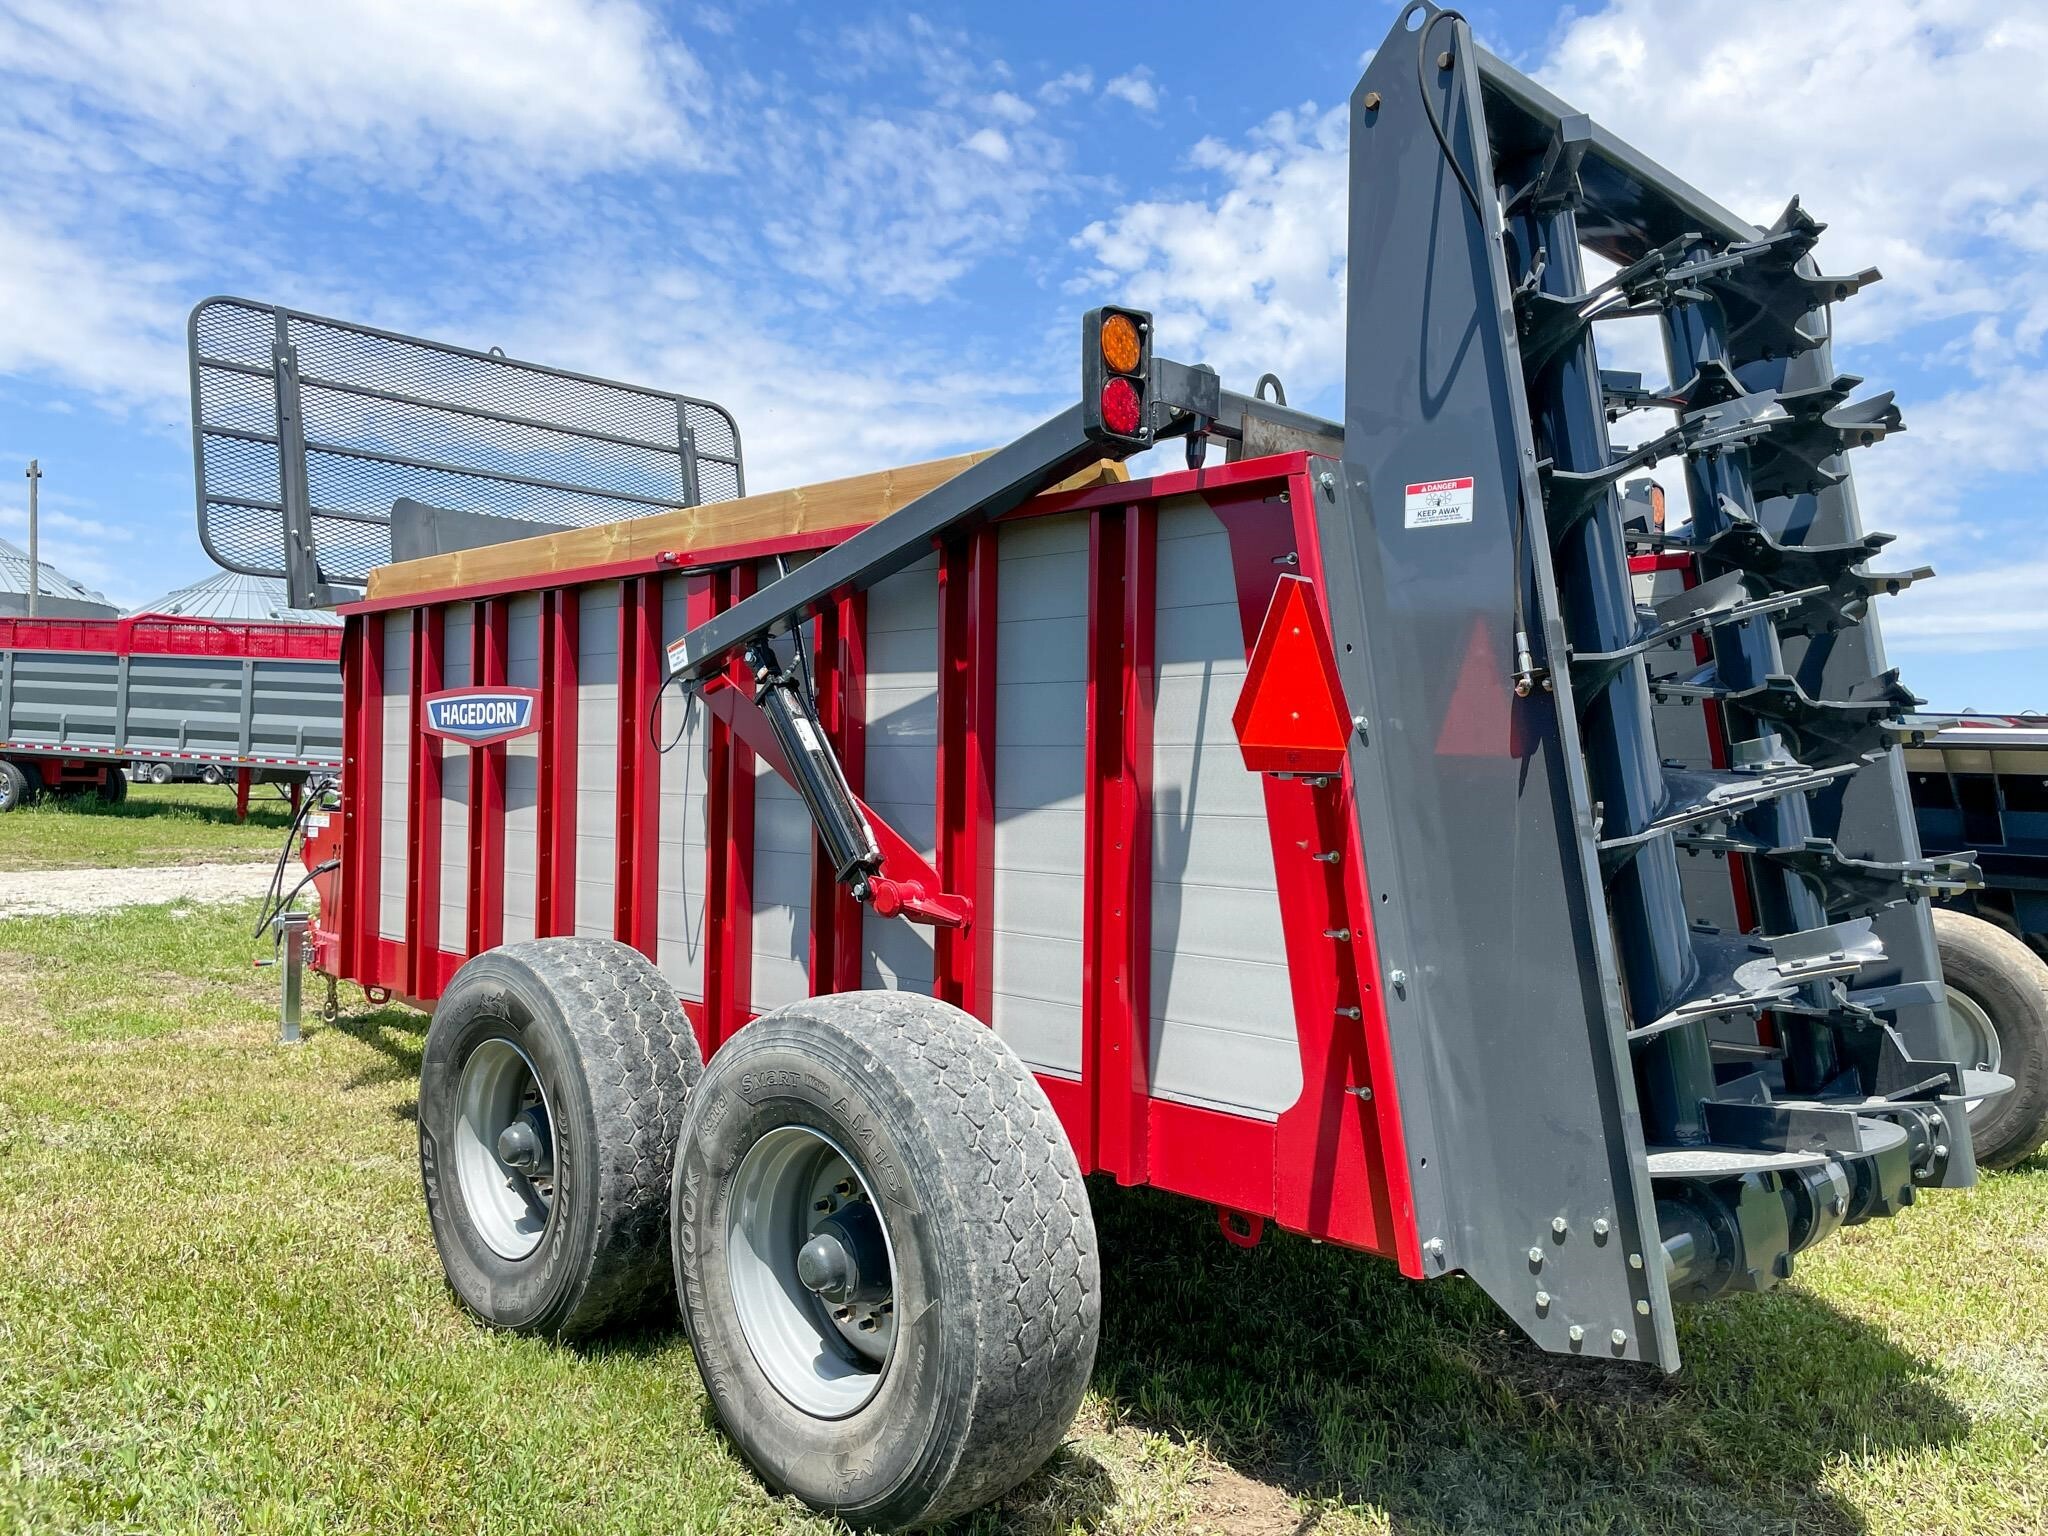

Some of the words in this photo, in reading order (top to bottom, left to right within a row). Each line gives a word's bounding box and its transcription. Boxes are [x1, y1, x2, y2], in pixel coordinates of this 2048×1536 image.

[1427, 482, 1457, 491] DANGER
[1417, 509, 1437, 517] KEEP
[1438, 506, 1460, 515] AWAY
[441, 701, 517, 725] HAGEDORN
